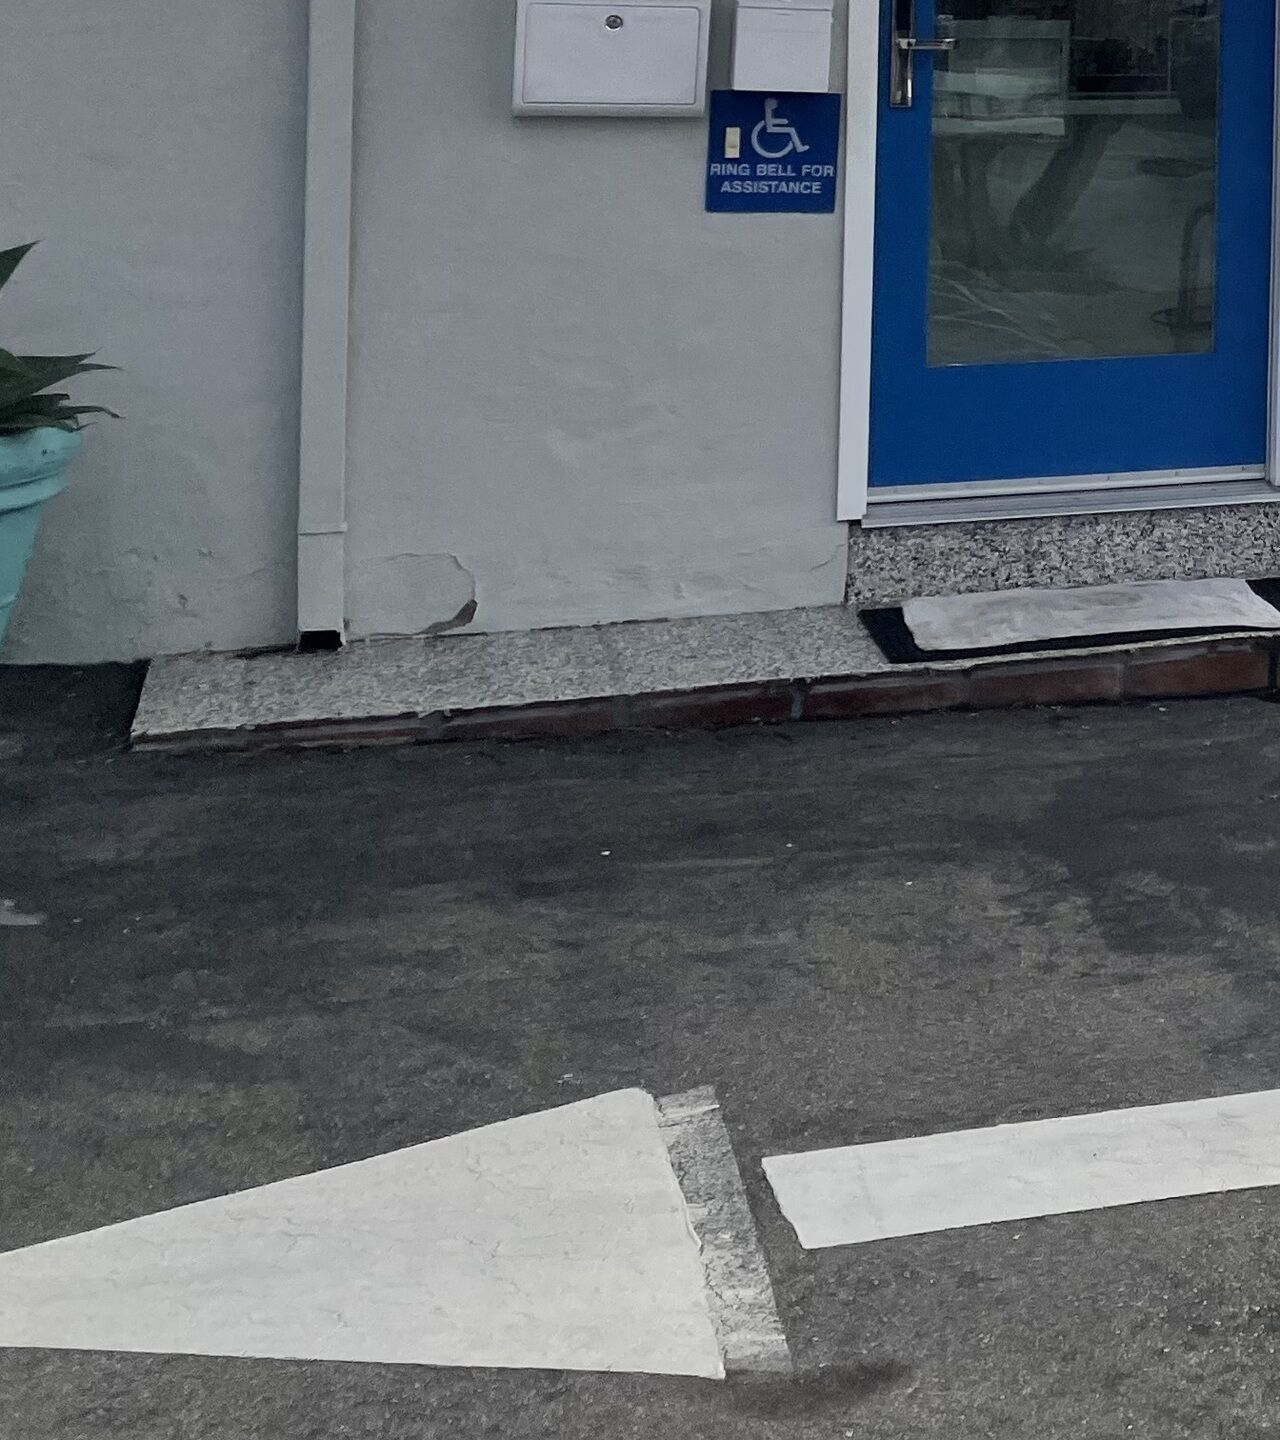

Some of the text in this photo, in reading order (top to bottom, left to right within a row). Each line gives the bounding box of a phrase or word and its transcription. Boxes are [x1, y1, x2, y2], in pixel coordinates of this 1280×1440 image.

[709, 163, 835, 177] RING BELL FOR
[720, 180, 823, 194] ASSISTANCE
